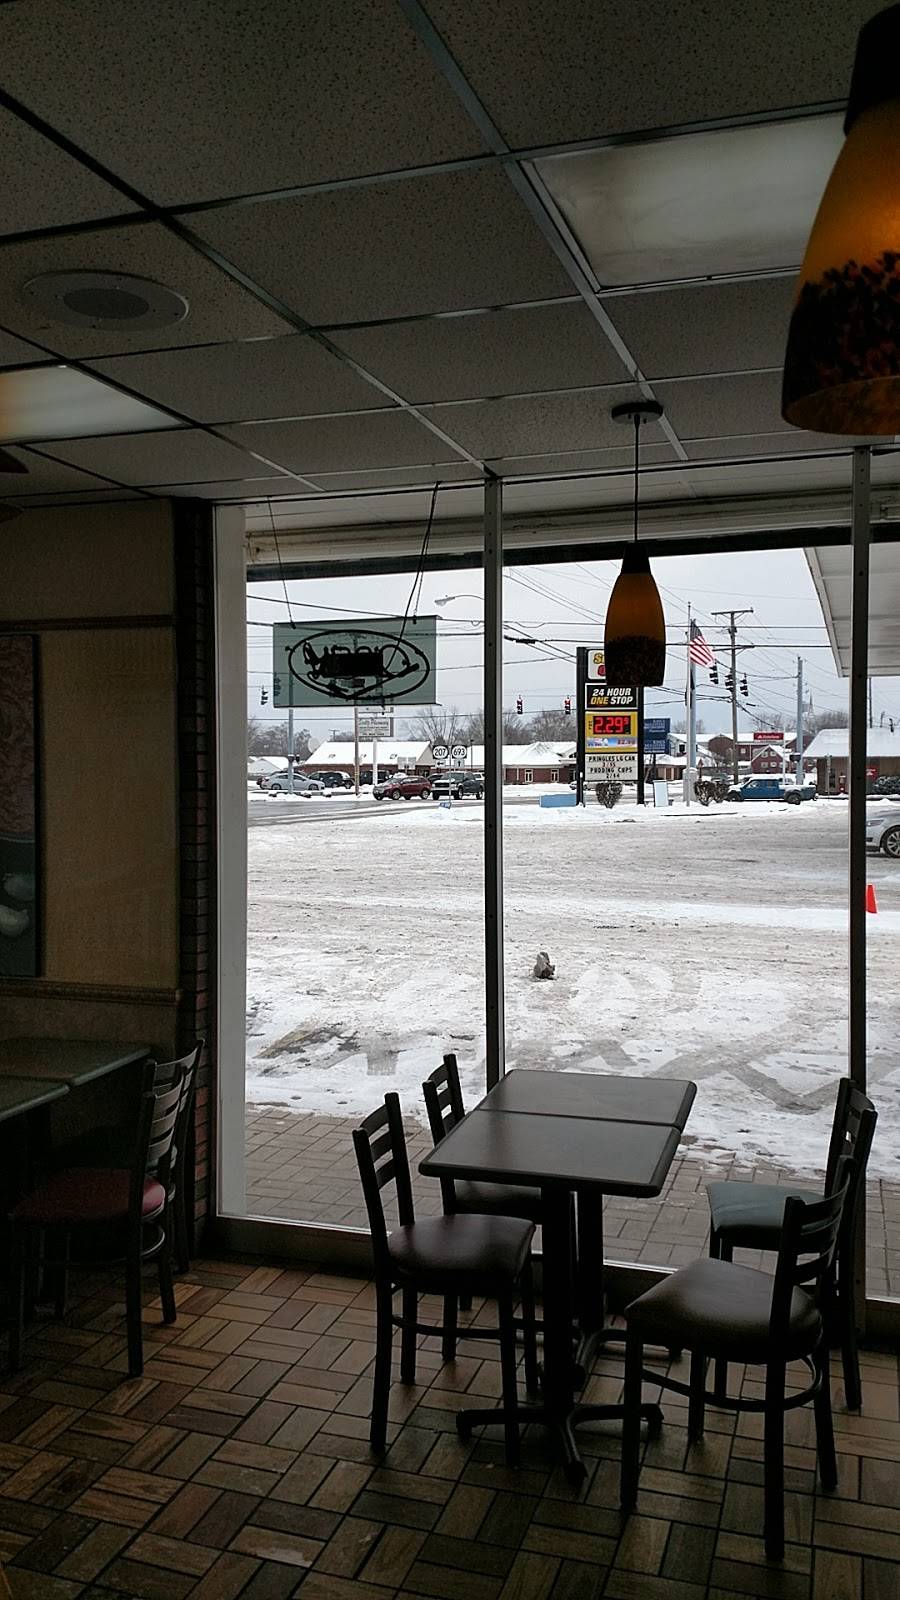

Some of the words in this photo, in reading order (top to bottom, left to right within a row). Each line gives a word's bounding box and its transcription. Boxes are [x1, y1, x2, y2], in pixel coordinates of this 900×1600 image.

[592, 688, 605, 697] 24
[606, 688, 632, 697] HOUR
[590, 696, 609, 705] ONE
[610, 696, 634, 705] STOP
[435, 748, 446, 756] 207
[454, 748, 465, 756] 693
